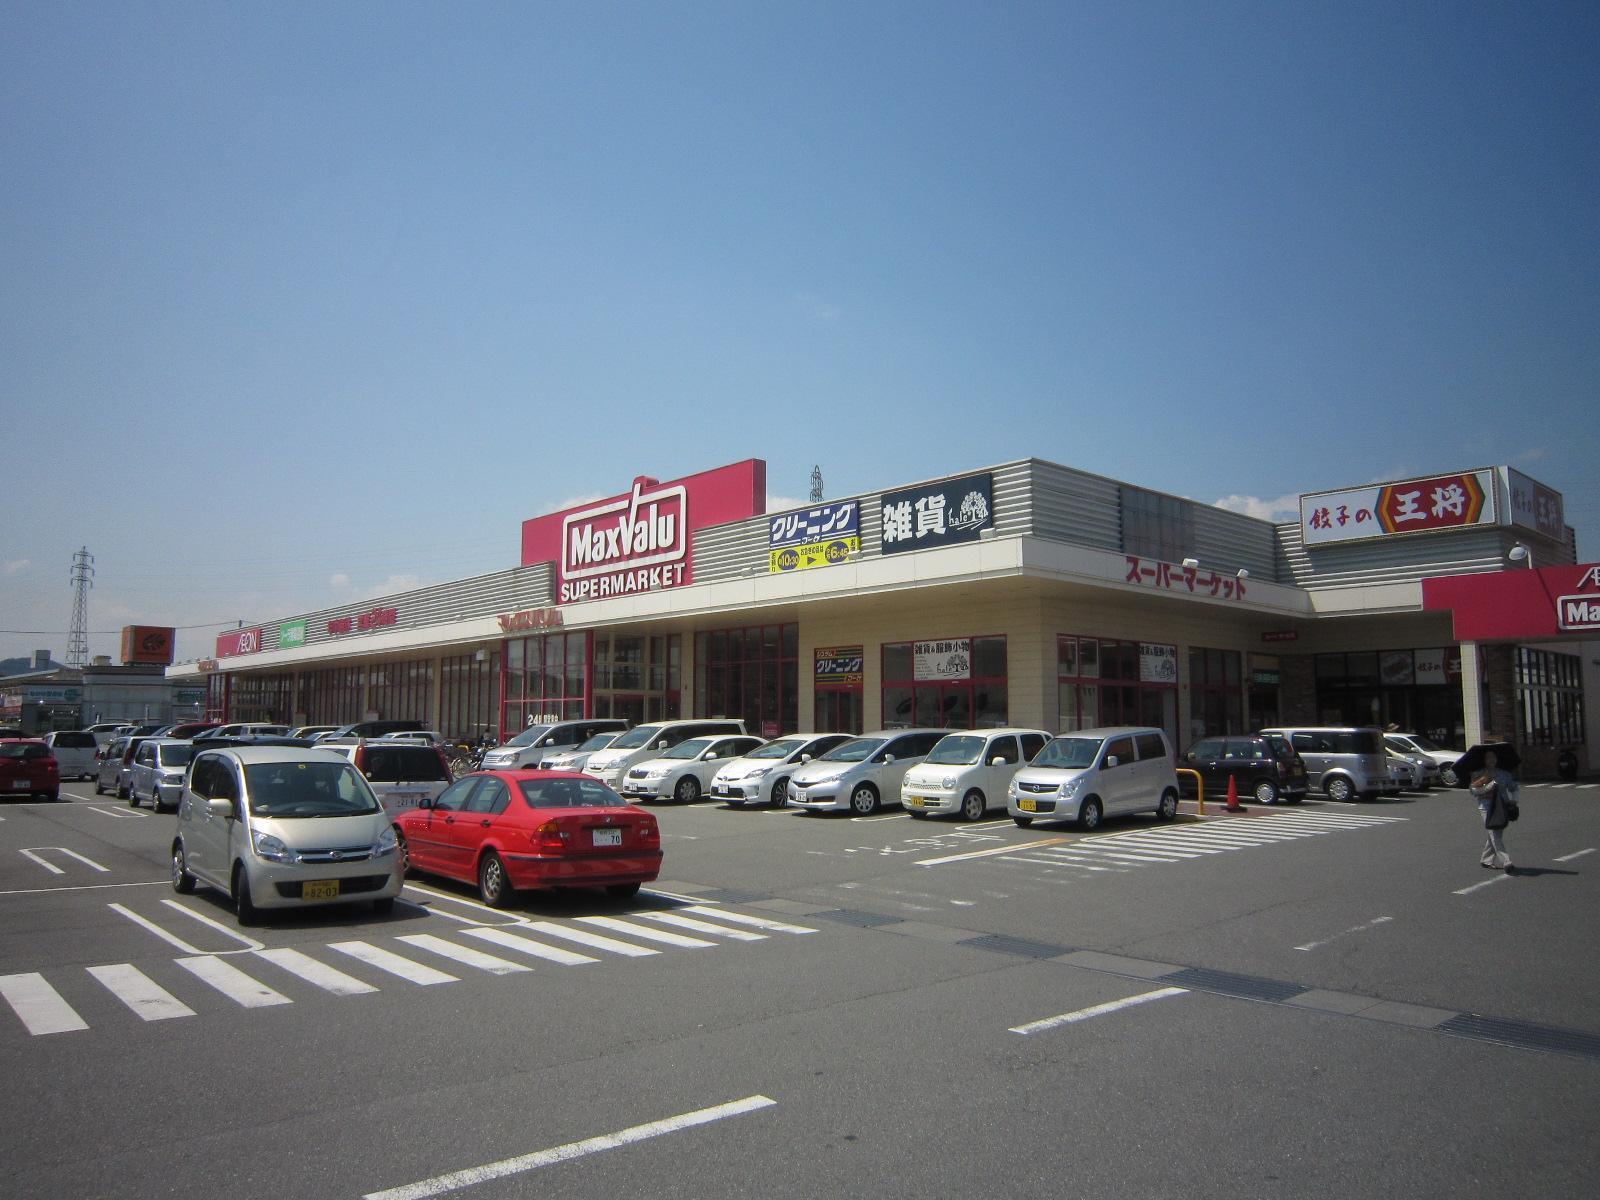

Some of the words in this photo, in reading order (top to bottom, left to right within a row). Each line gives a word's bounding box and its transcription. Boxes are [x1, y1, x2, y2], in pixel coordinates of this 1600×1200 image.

[571, 483, 675, 566] MaxValu
[772, 504, 856, 541] クリーニング
[883, 494, 946, 542] 雑貨
[1309, 505, 1372, 529] 餃子の
[1394, 483, 1465, 523] 王将
[561, 563, 686, 602] SUPERMARKET
[1126, 555, 1246, 600] スーパーマーケット
[816, 658, 862, 672] クリーニング
